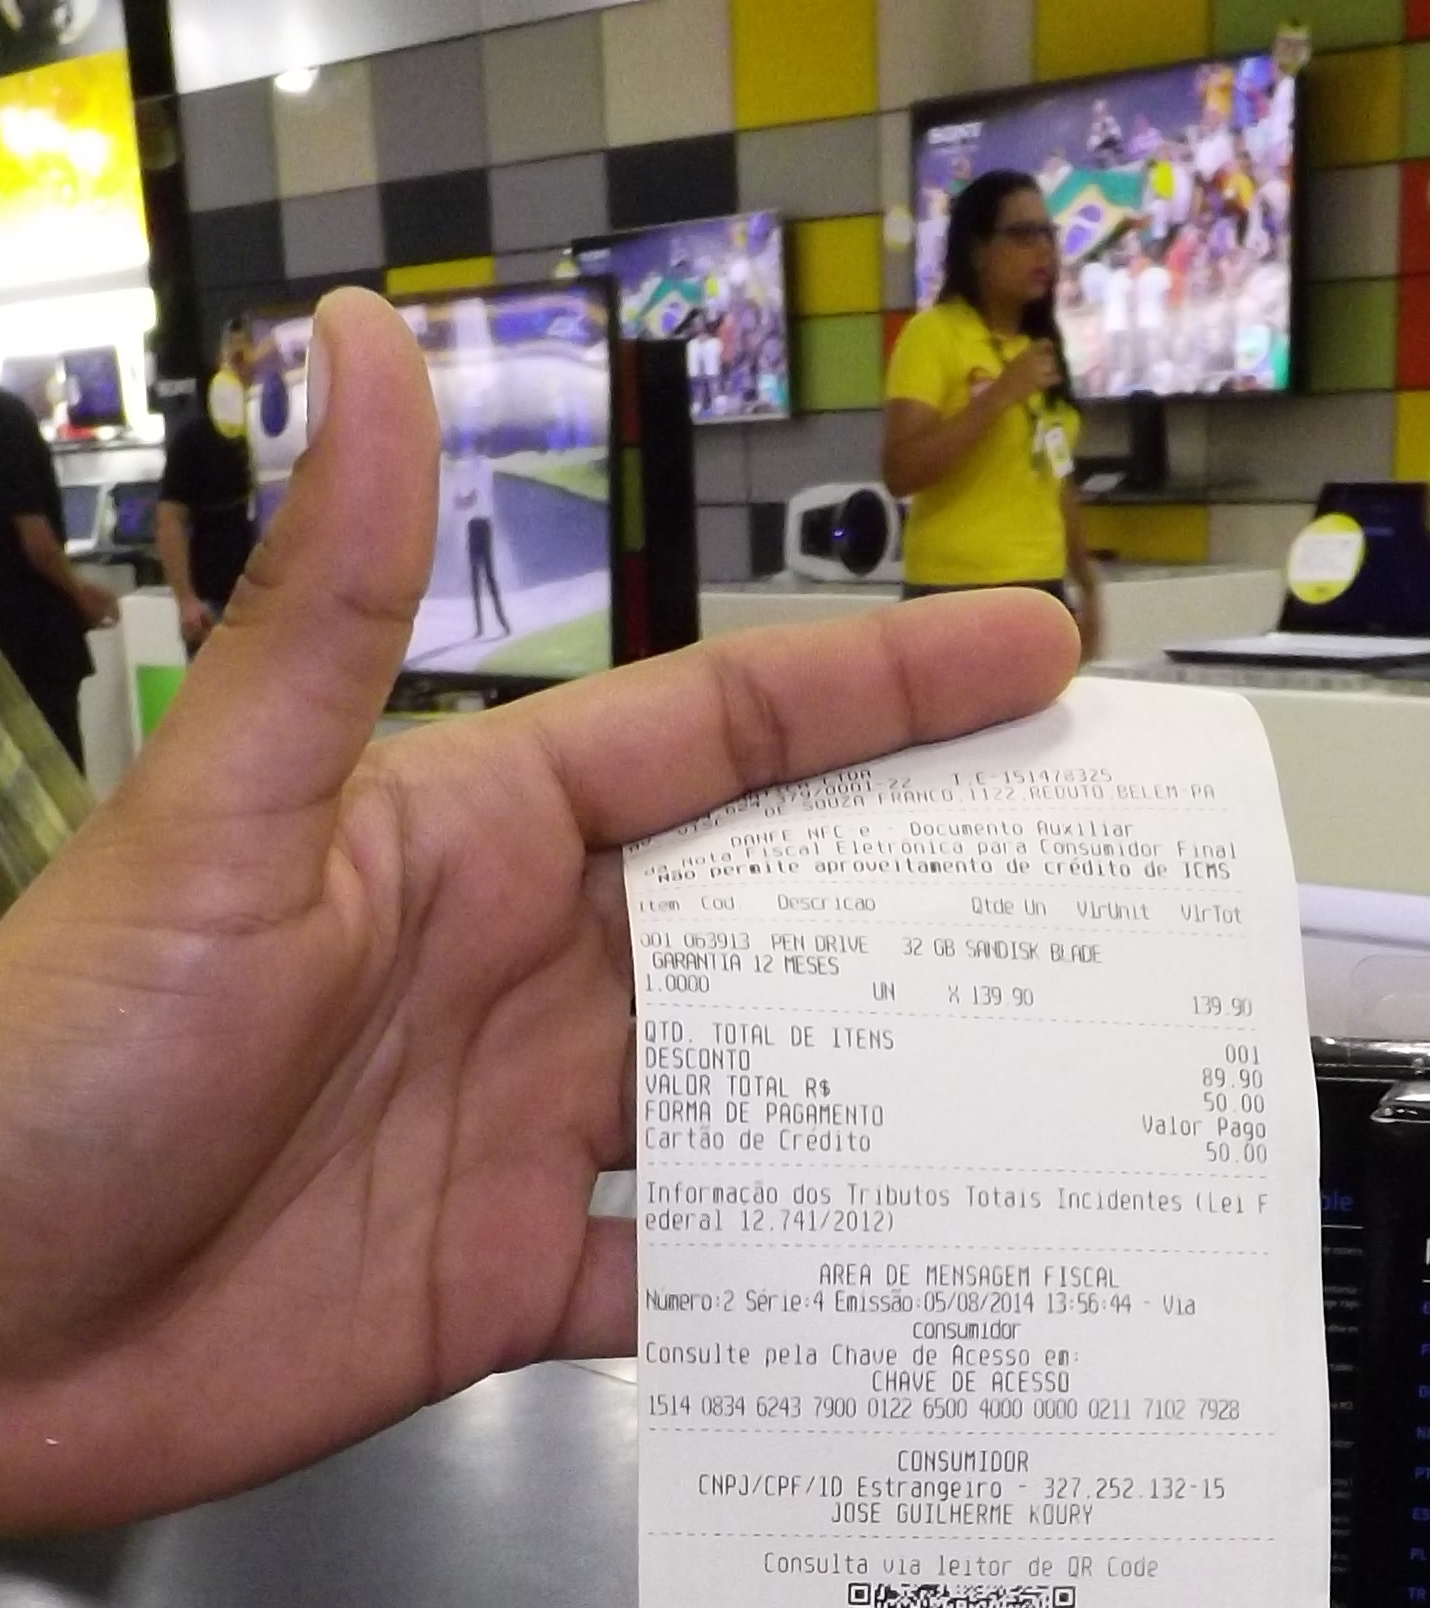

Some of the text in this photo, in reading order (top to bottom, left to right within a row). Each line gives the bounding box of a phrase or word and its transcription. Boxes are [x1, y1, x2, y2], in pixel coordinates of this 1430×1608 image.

[910, 820, 1134, 837] Documento Auxiliar
[746, 838, 1237, 861] Fiscal Consumidor Final
[710, 855, 1232, 881] permite aproveitamento de crédito de ICMS
[971, 896, 1015, 916] Qtde
[771, 933, 1039, 960] PEN DRIVE SANDISK
[652, 951, 840, 976] GARANTIA 12 MESES
[644, 973, 1253, 1018] 1.0000 UN 139.90 139.90
[644, 1020, 1262, 1066] QTD. TOTAL DE ITENS 001
[644, 1047, 1264, 1091] DESCONTO 89.90
[644, 1074, 1266, 1116] VALOR TOTAL R$ 50.00
[644, 1099, 1269, 1143] FORMA DE PAGAMENTO Valor Pago
[644, 1125, 1269, 1166] Cartão de Crédito 50.00
[646, 1180, 1245, 1216] Informação dos Tributos Totais Incidentes (Lei
[644, 1208, 895, 1234] ederal 12.741/2012)
[819, 1262, 1121, 1289] AREA DE MENSAGEM FISCAL
[745, 1287, 1197, 1318] Série:4 Emissão:05/08/2014 13:56:44 Via
[911, 1318, 1021, 1340] consumidor
[644, 1340, 1031, 1369] Consulte pela Chave de Acesso
[871, 1369, 1070, 1395] CHAVE DE ACESSO
[648, 1393, 1241, 1421] 1514 0834 6243 7900 0122 6500 4000 0000 0211 7928
[897, 1449, 1030, 1473] CONSUMIDOR
[857, 1475, 1226, 1502] Estrangeiro 327.252.132-15
[830, 1500, 1094, 1526] JOSE GUILHERME KOURY
[762, 1551, 1160, 1580] Consulta via leitor de QR Code
